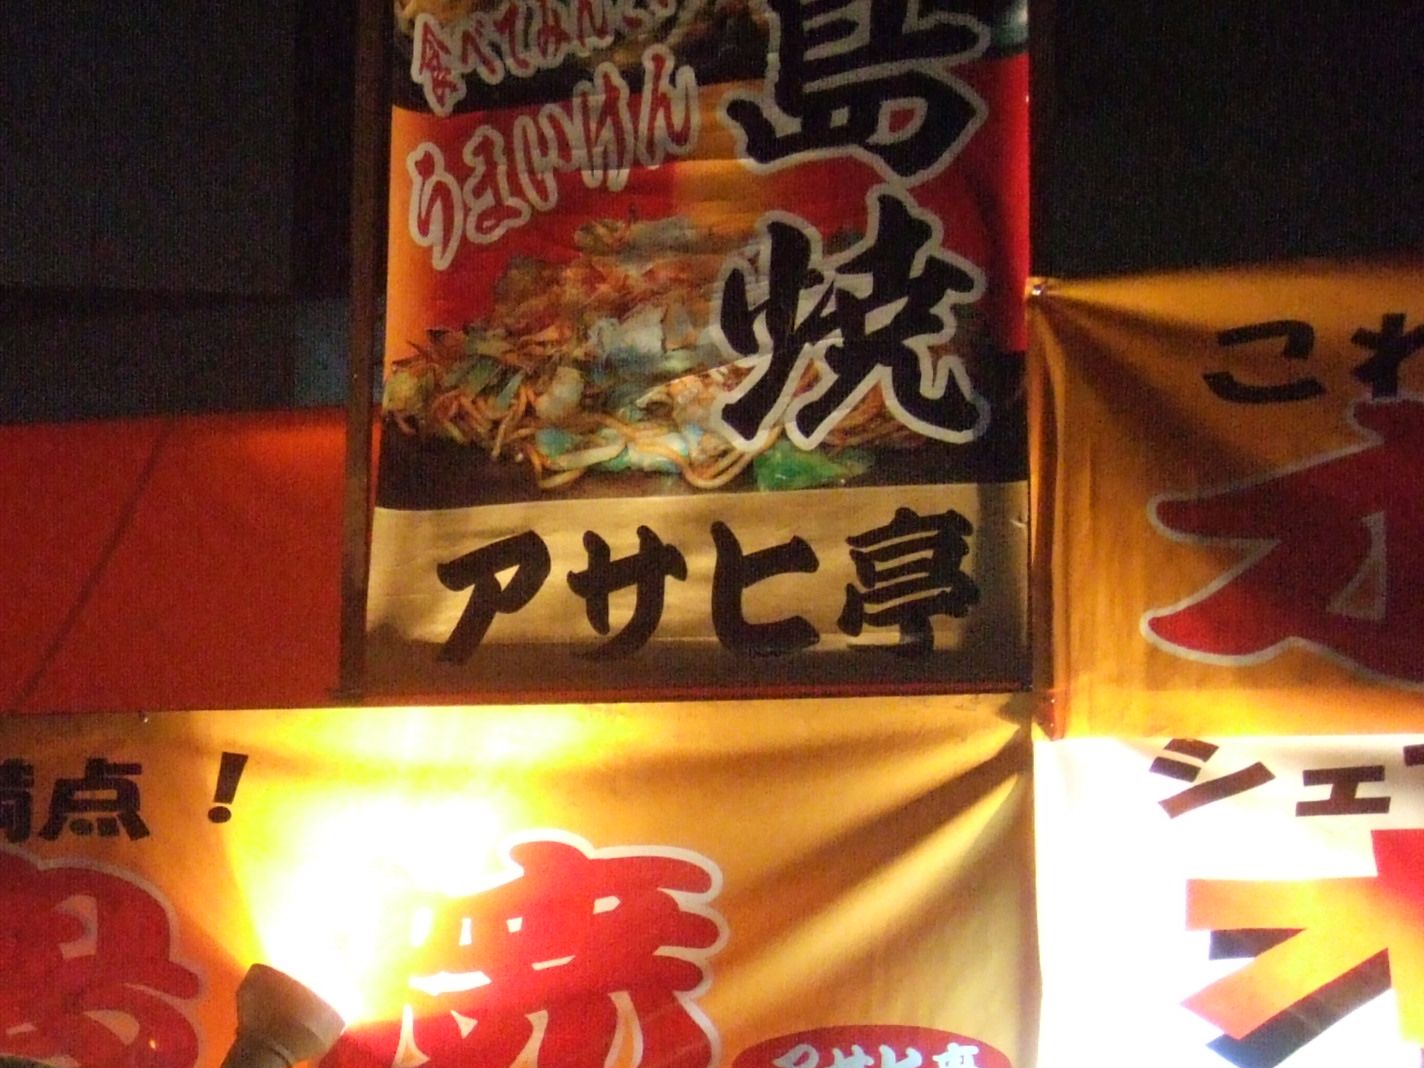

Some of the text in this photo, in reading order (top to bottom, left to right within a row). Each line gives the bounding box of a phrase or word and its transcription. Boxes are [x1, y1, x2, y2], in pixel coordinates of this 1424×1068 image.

[435, 507, 979, 665] アサヒ亭
[1150, 738, 1424, 819] シェ
